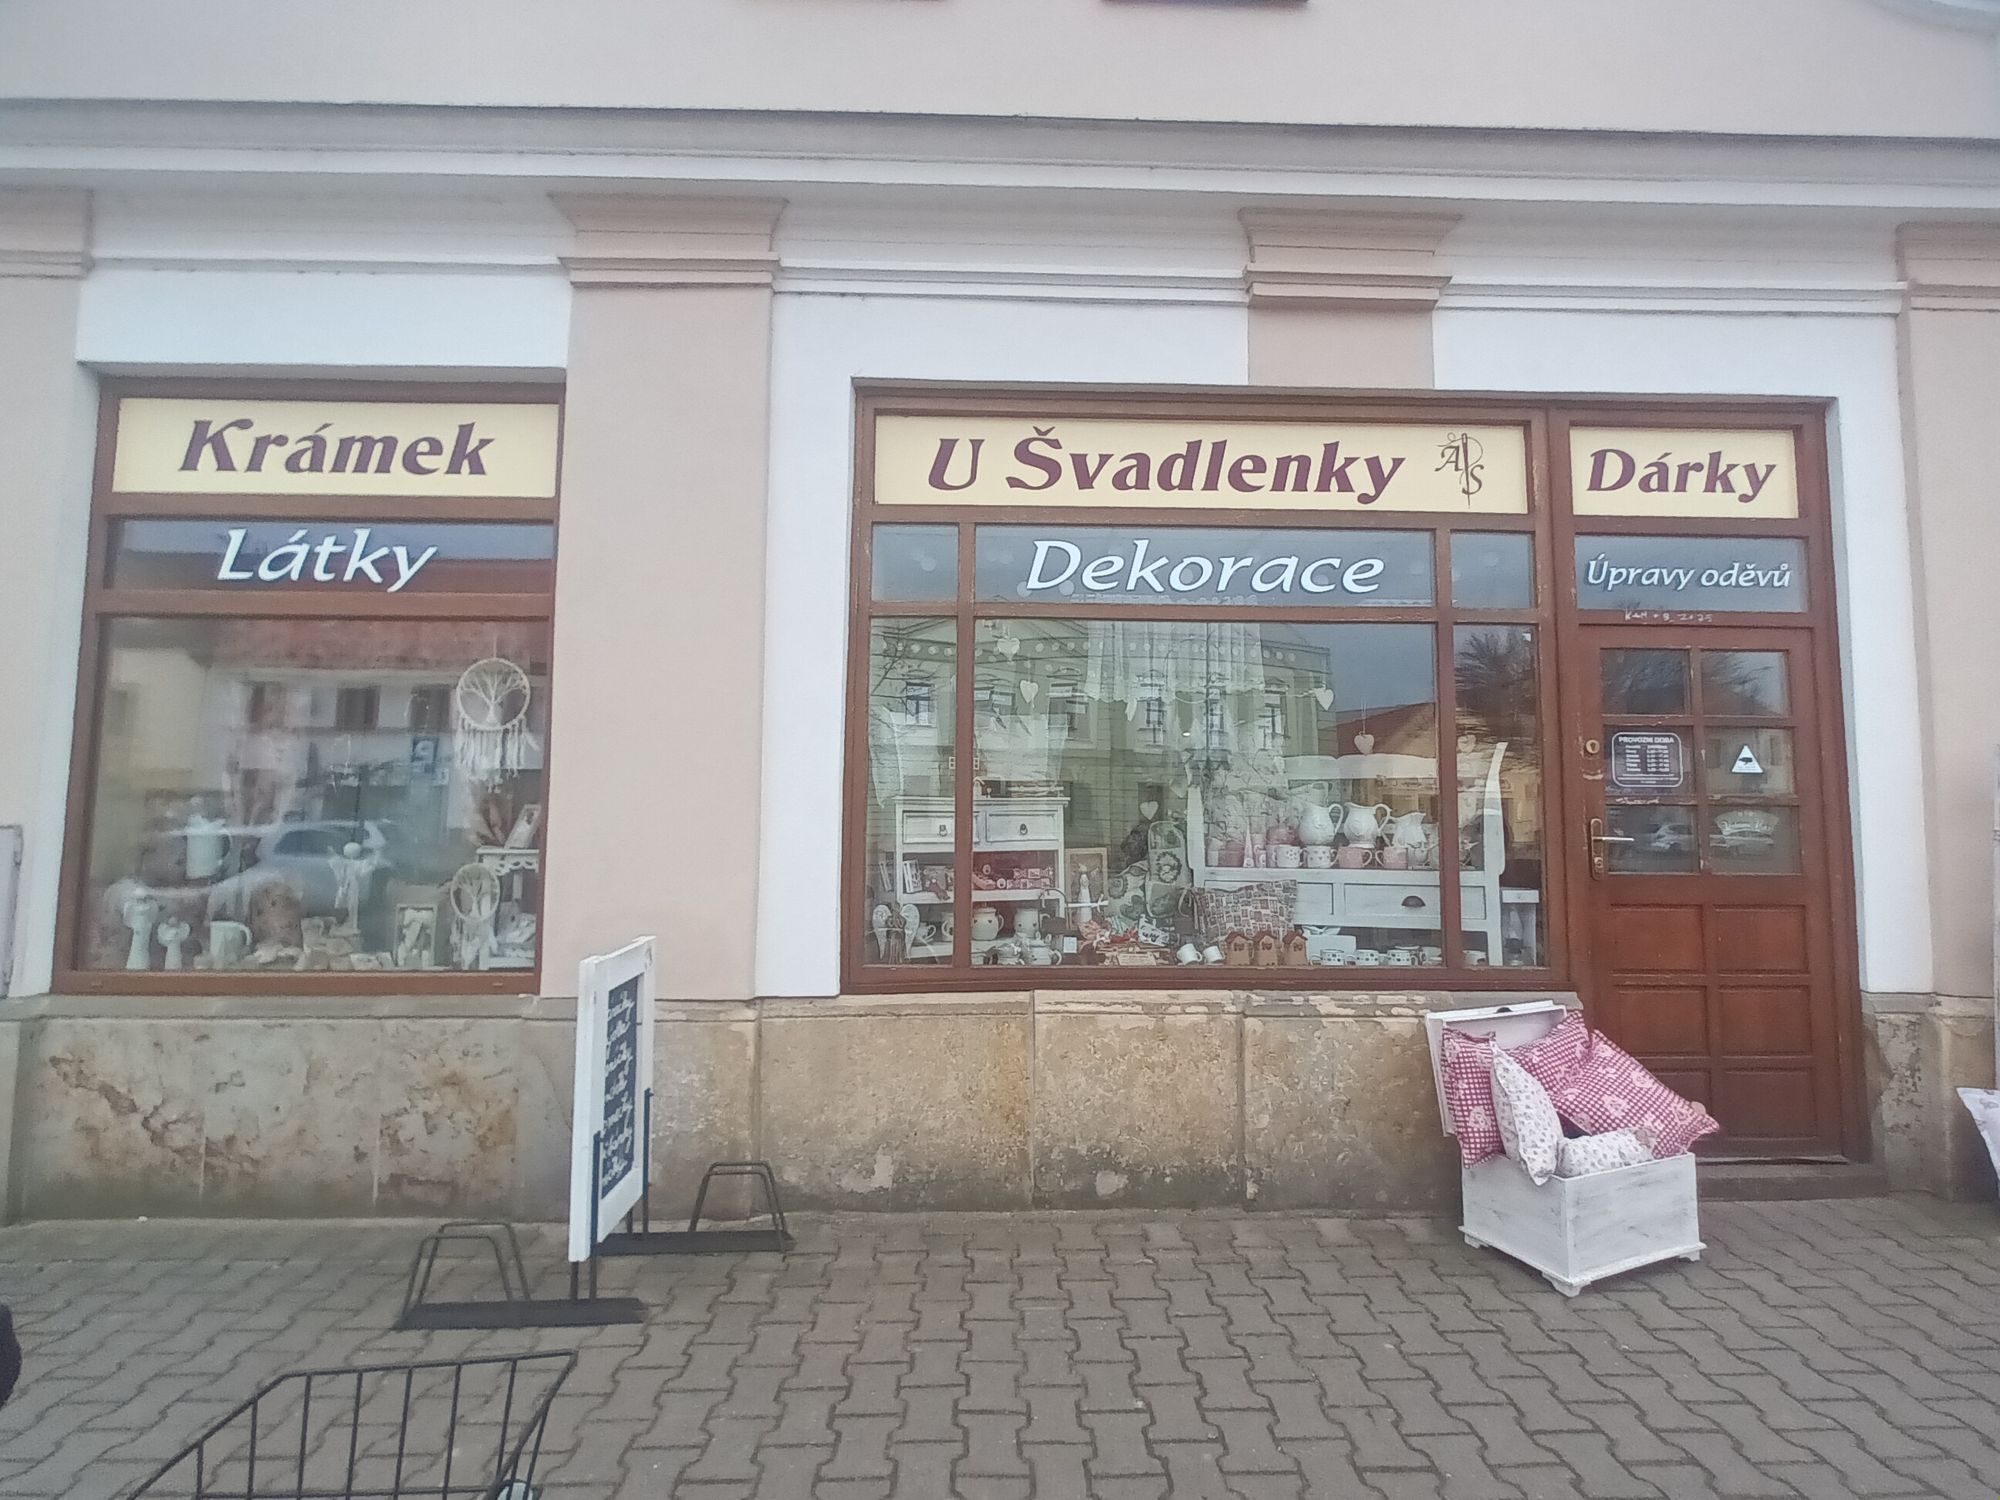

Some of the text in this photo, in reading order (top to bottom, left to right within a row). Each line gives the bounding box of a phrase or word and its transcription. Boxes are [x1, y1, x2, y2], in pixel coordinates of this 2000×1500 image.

[178, 418, 495, 476] Krámek
[928, 425, 1406, 505] U Švadlenky
[1586, 448, 1777, 503] Dárky
[217, 527, 438, 593] Látky
[1026, 539, 1384, 593] Dekorace
[1587, 553, 1792, 592] Úpravy oděvů
